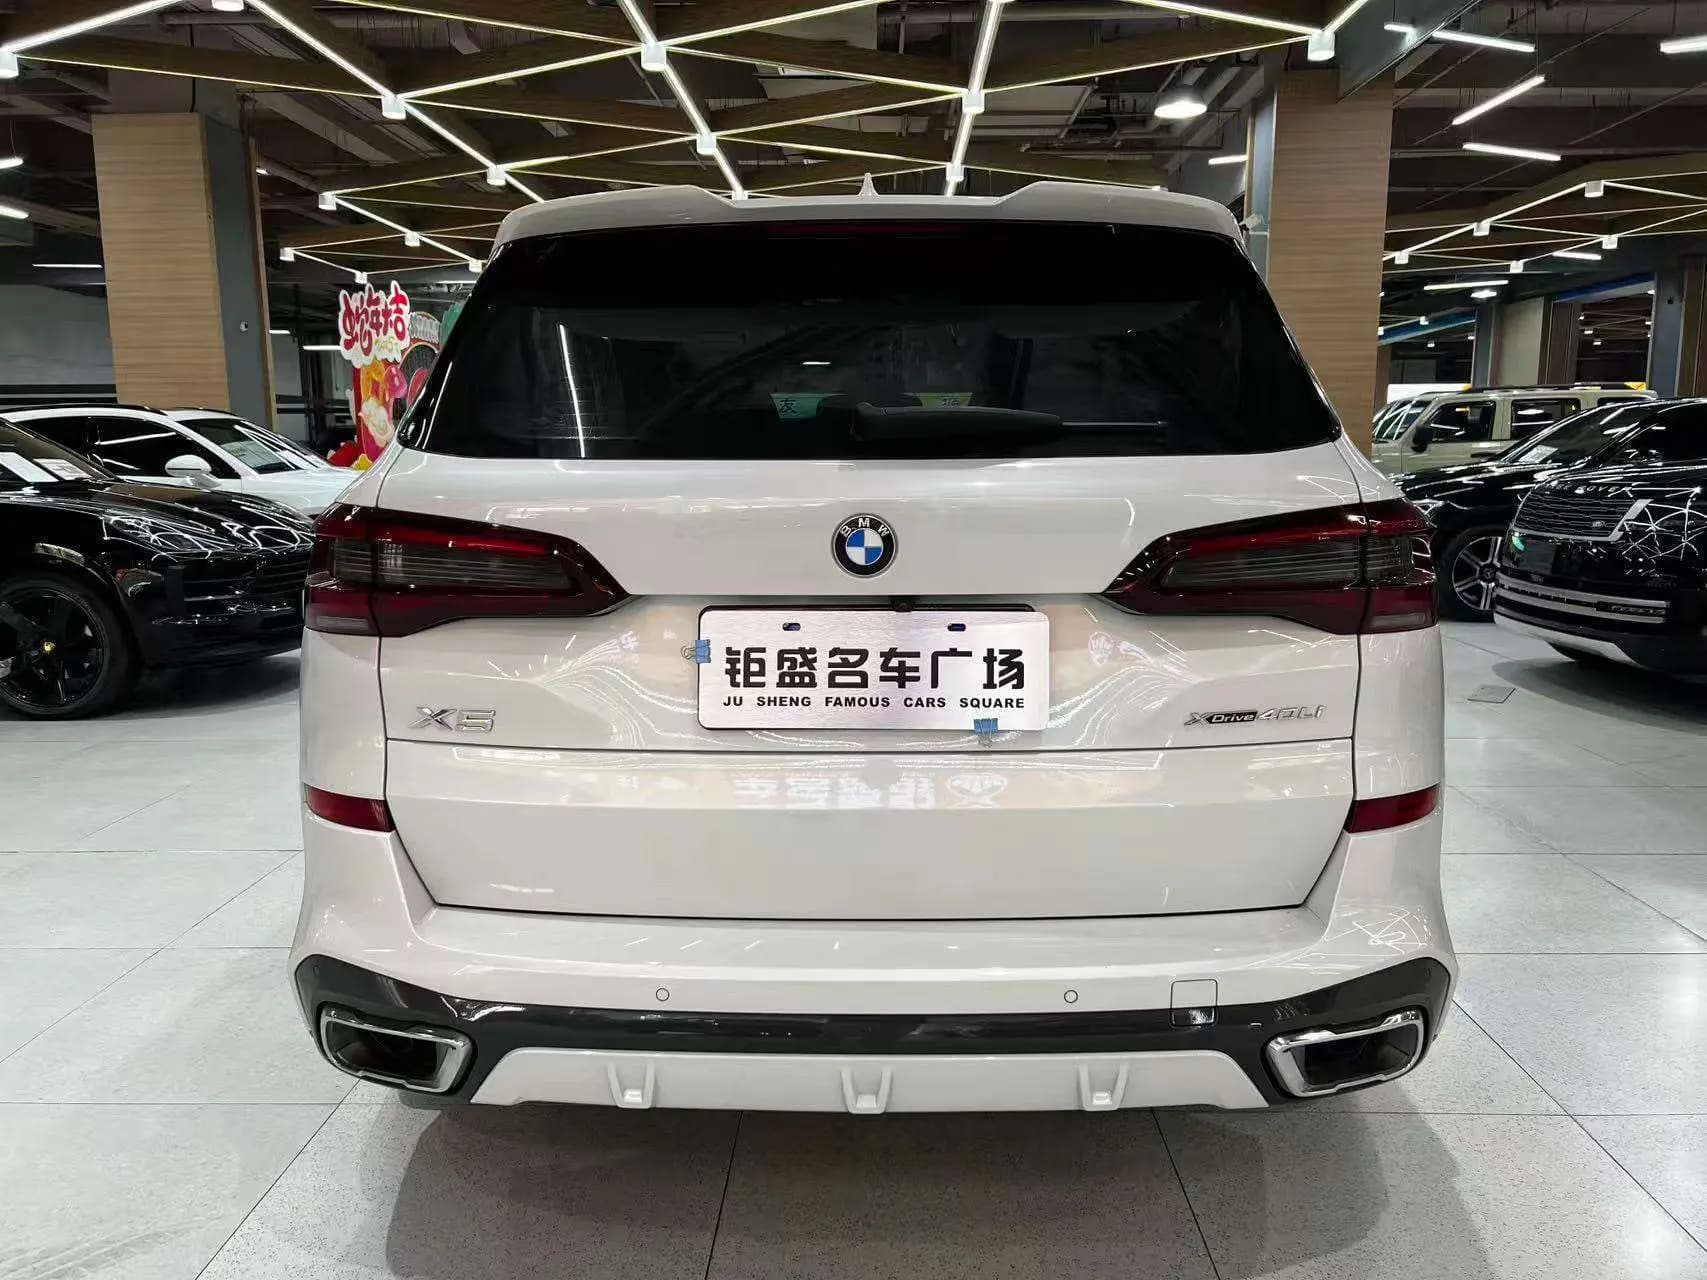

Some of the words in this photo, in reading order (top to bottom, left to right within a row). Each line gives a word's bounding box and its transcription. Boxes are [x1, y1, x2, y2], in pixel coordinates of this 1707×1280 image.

[840, 517, 890, 537] BMW
[724, 646, 1025, 690] 钜盛名车广场
[722, 696, 743, 708] JU
[756, 696, 812, 708] SHENG
[824, 696, 891, 708] FAMOUS
[903, 697, 946, 709] CARS
[959, 697, 1025, 709] SQUARE
[408, 705, 496, 733] X5
